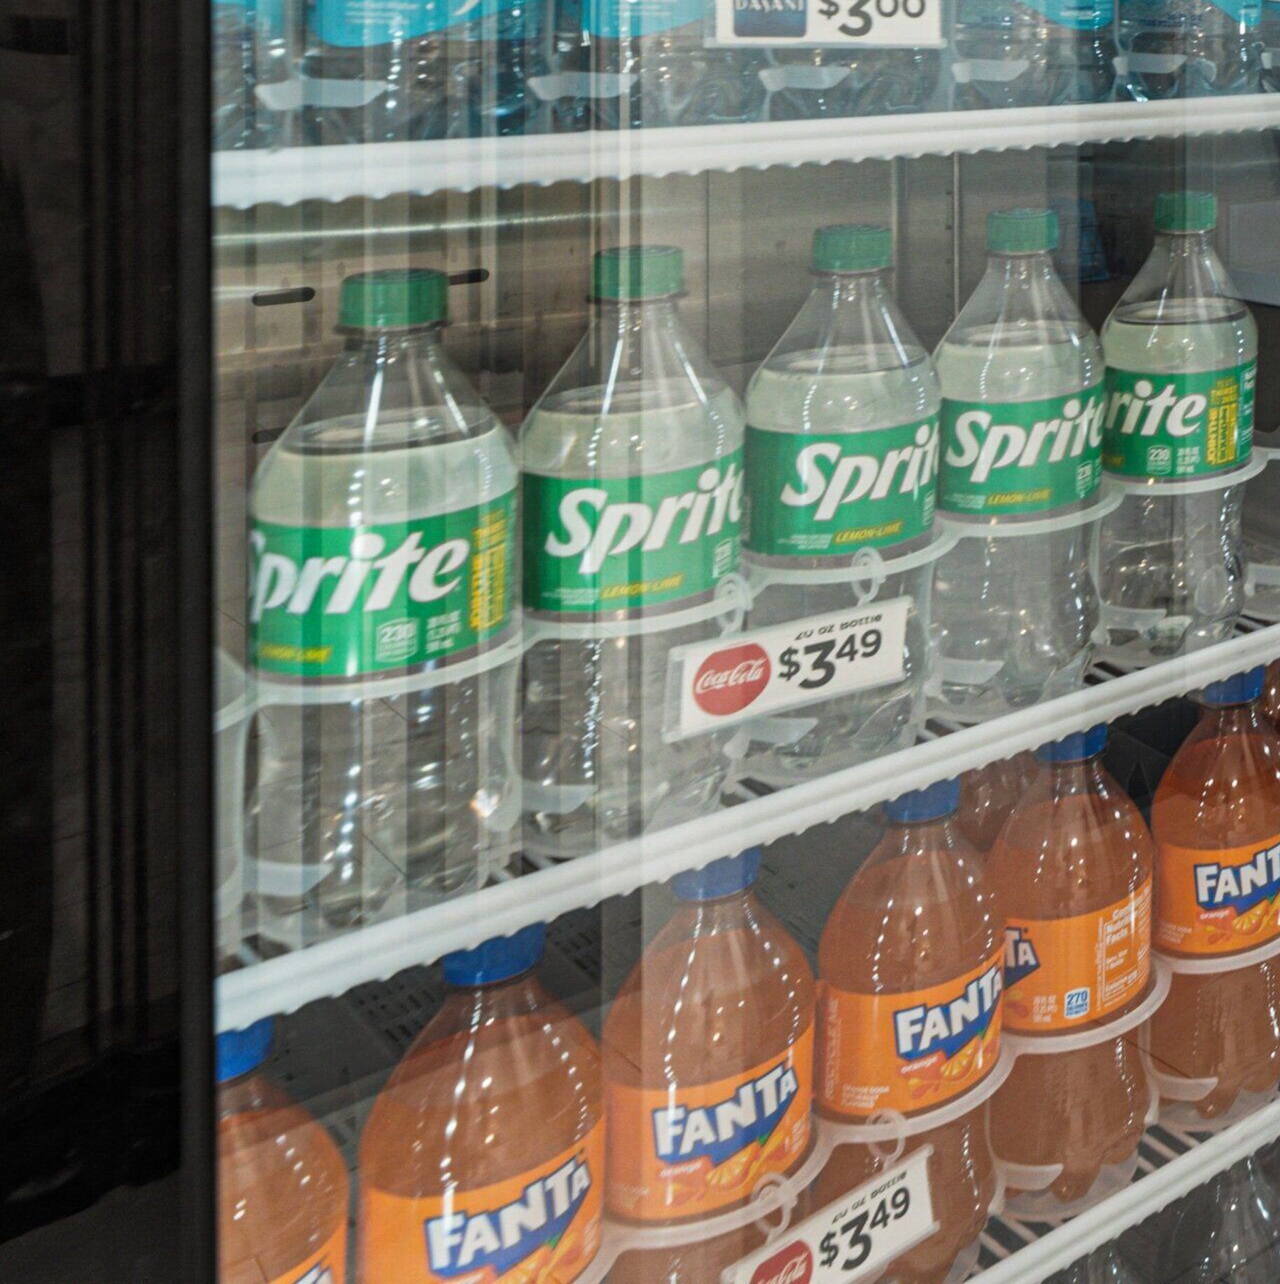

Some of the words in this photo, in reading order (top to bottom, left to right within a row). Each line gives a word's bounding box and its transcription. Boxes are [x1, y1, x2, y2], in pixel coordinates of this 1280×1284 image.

[1105, 379, 1208, 438] rite
[779, 421, 940, 522] Sprit
[695, 656, 769, 695] Coca-Cola
[654, 1063, 798, 1156] FANTA
[426, 1157, 593, 1271] FANTA
